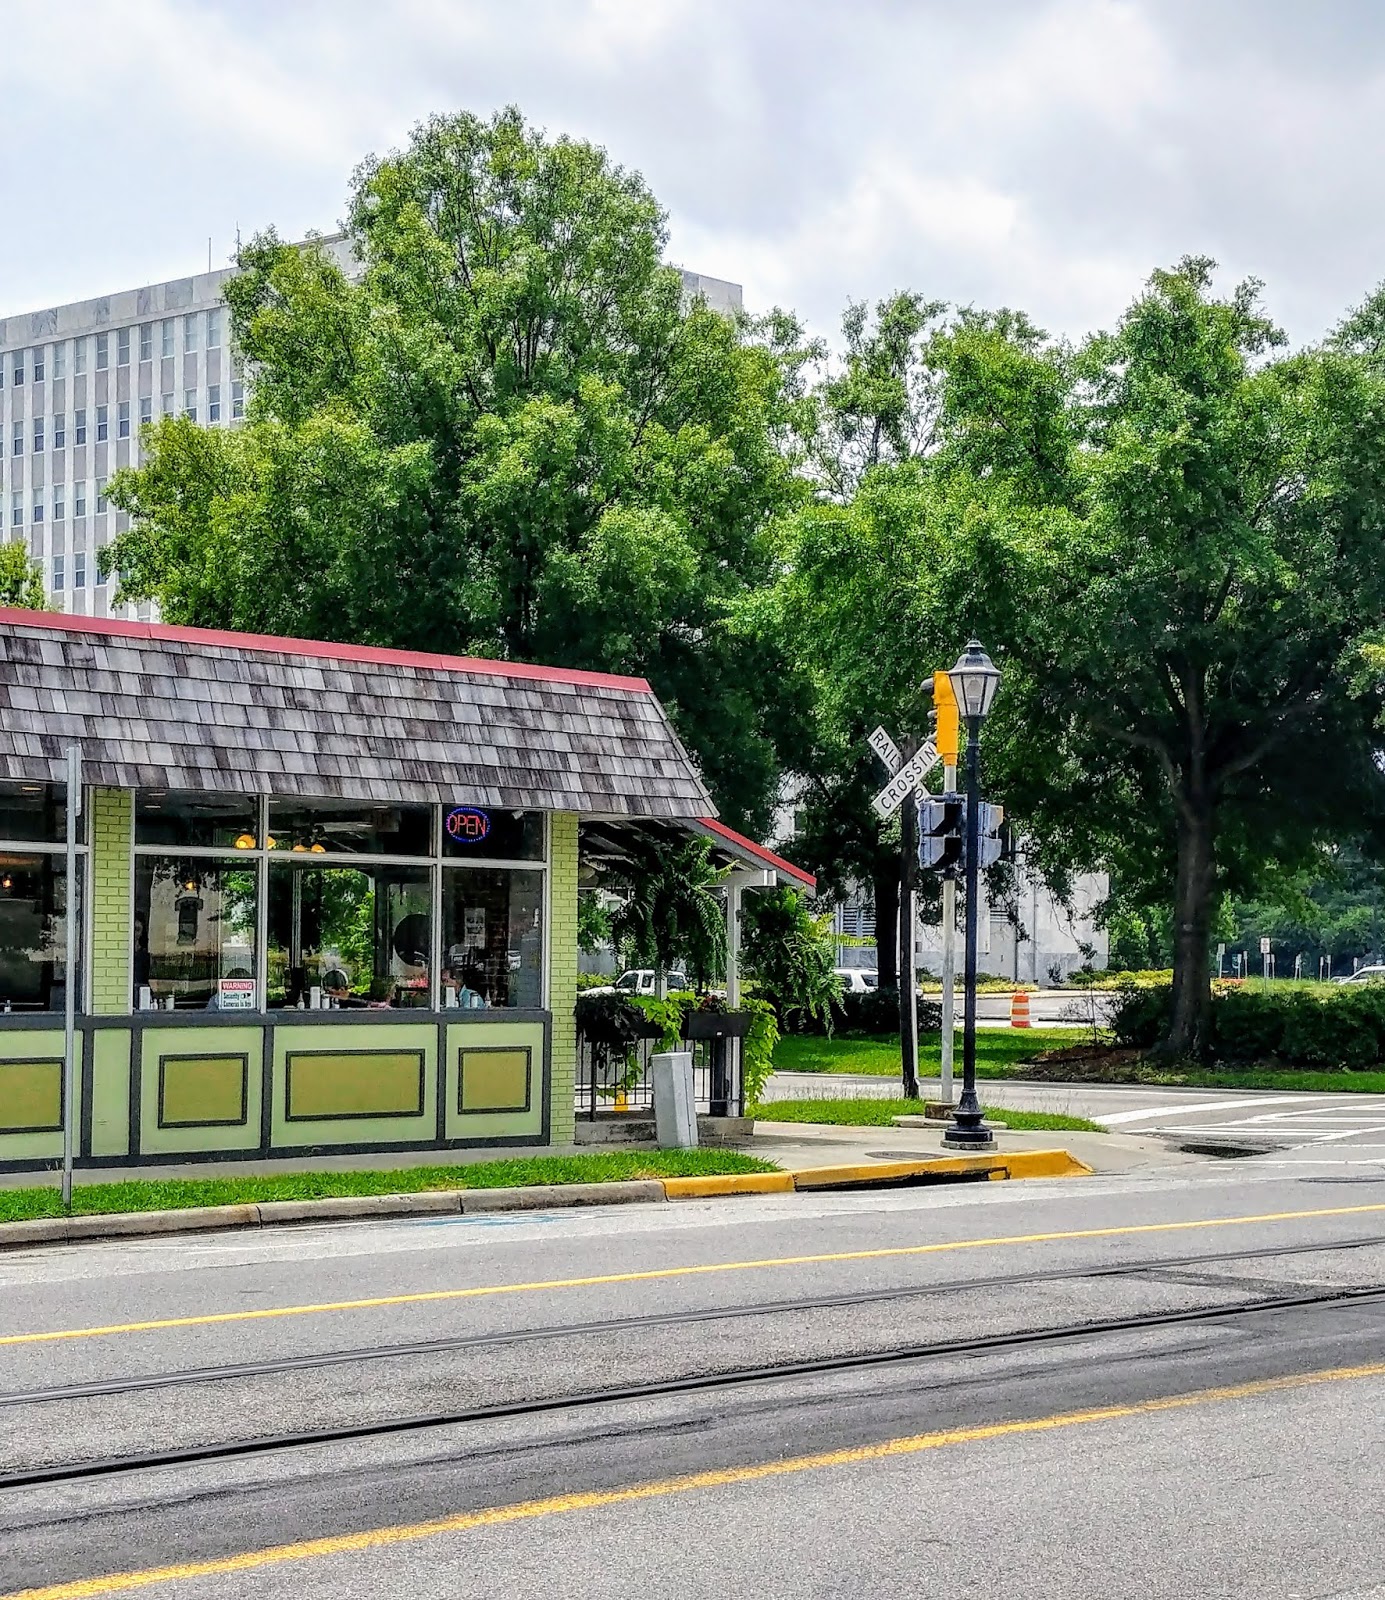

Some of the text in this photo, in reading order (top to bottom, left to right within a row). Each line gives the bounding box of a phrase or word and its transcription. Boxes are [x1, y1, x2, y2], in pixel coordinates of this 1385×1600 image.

[873, 732, 898, 768] RAIL
[881, 746, 937, 809] CROSSIN
[447, 814, 486, 837] OPEN
[222, 982, 253, 990] WARNING
